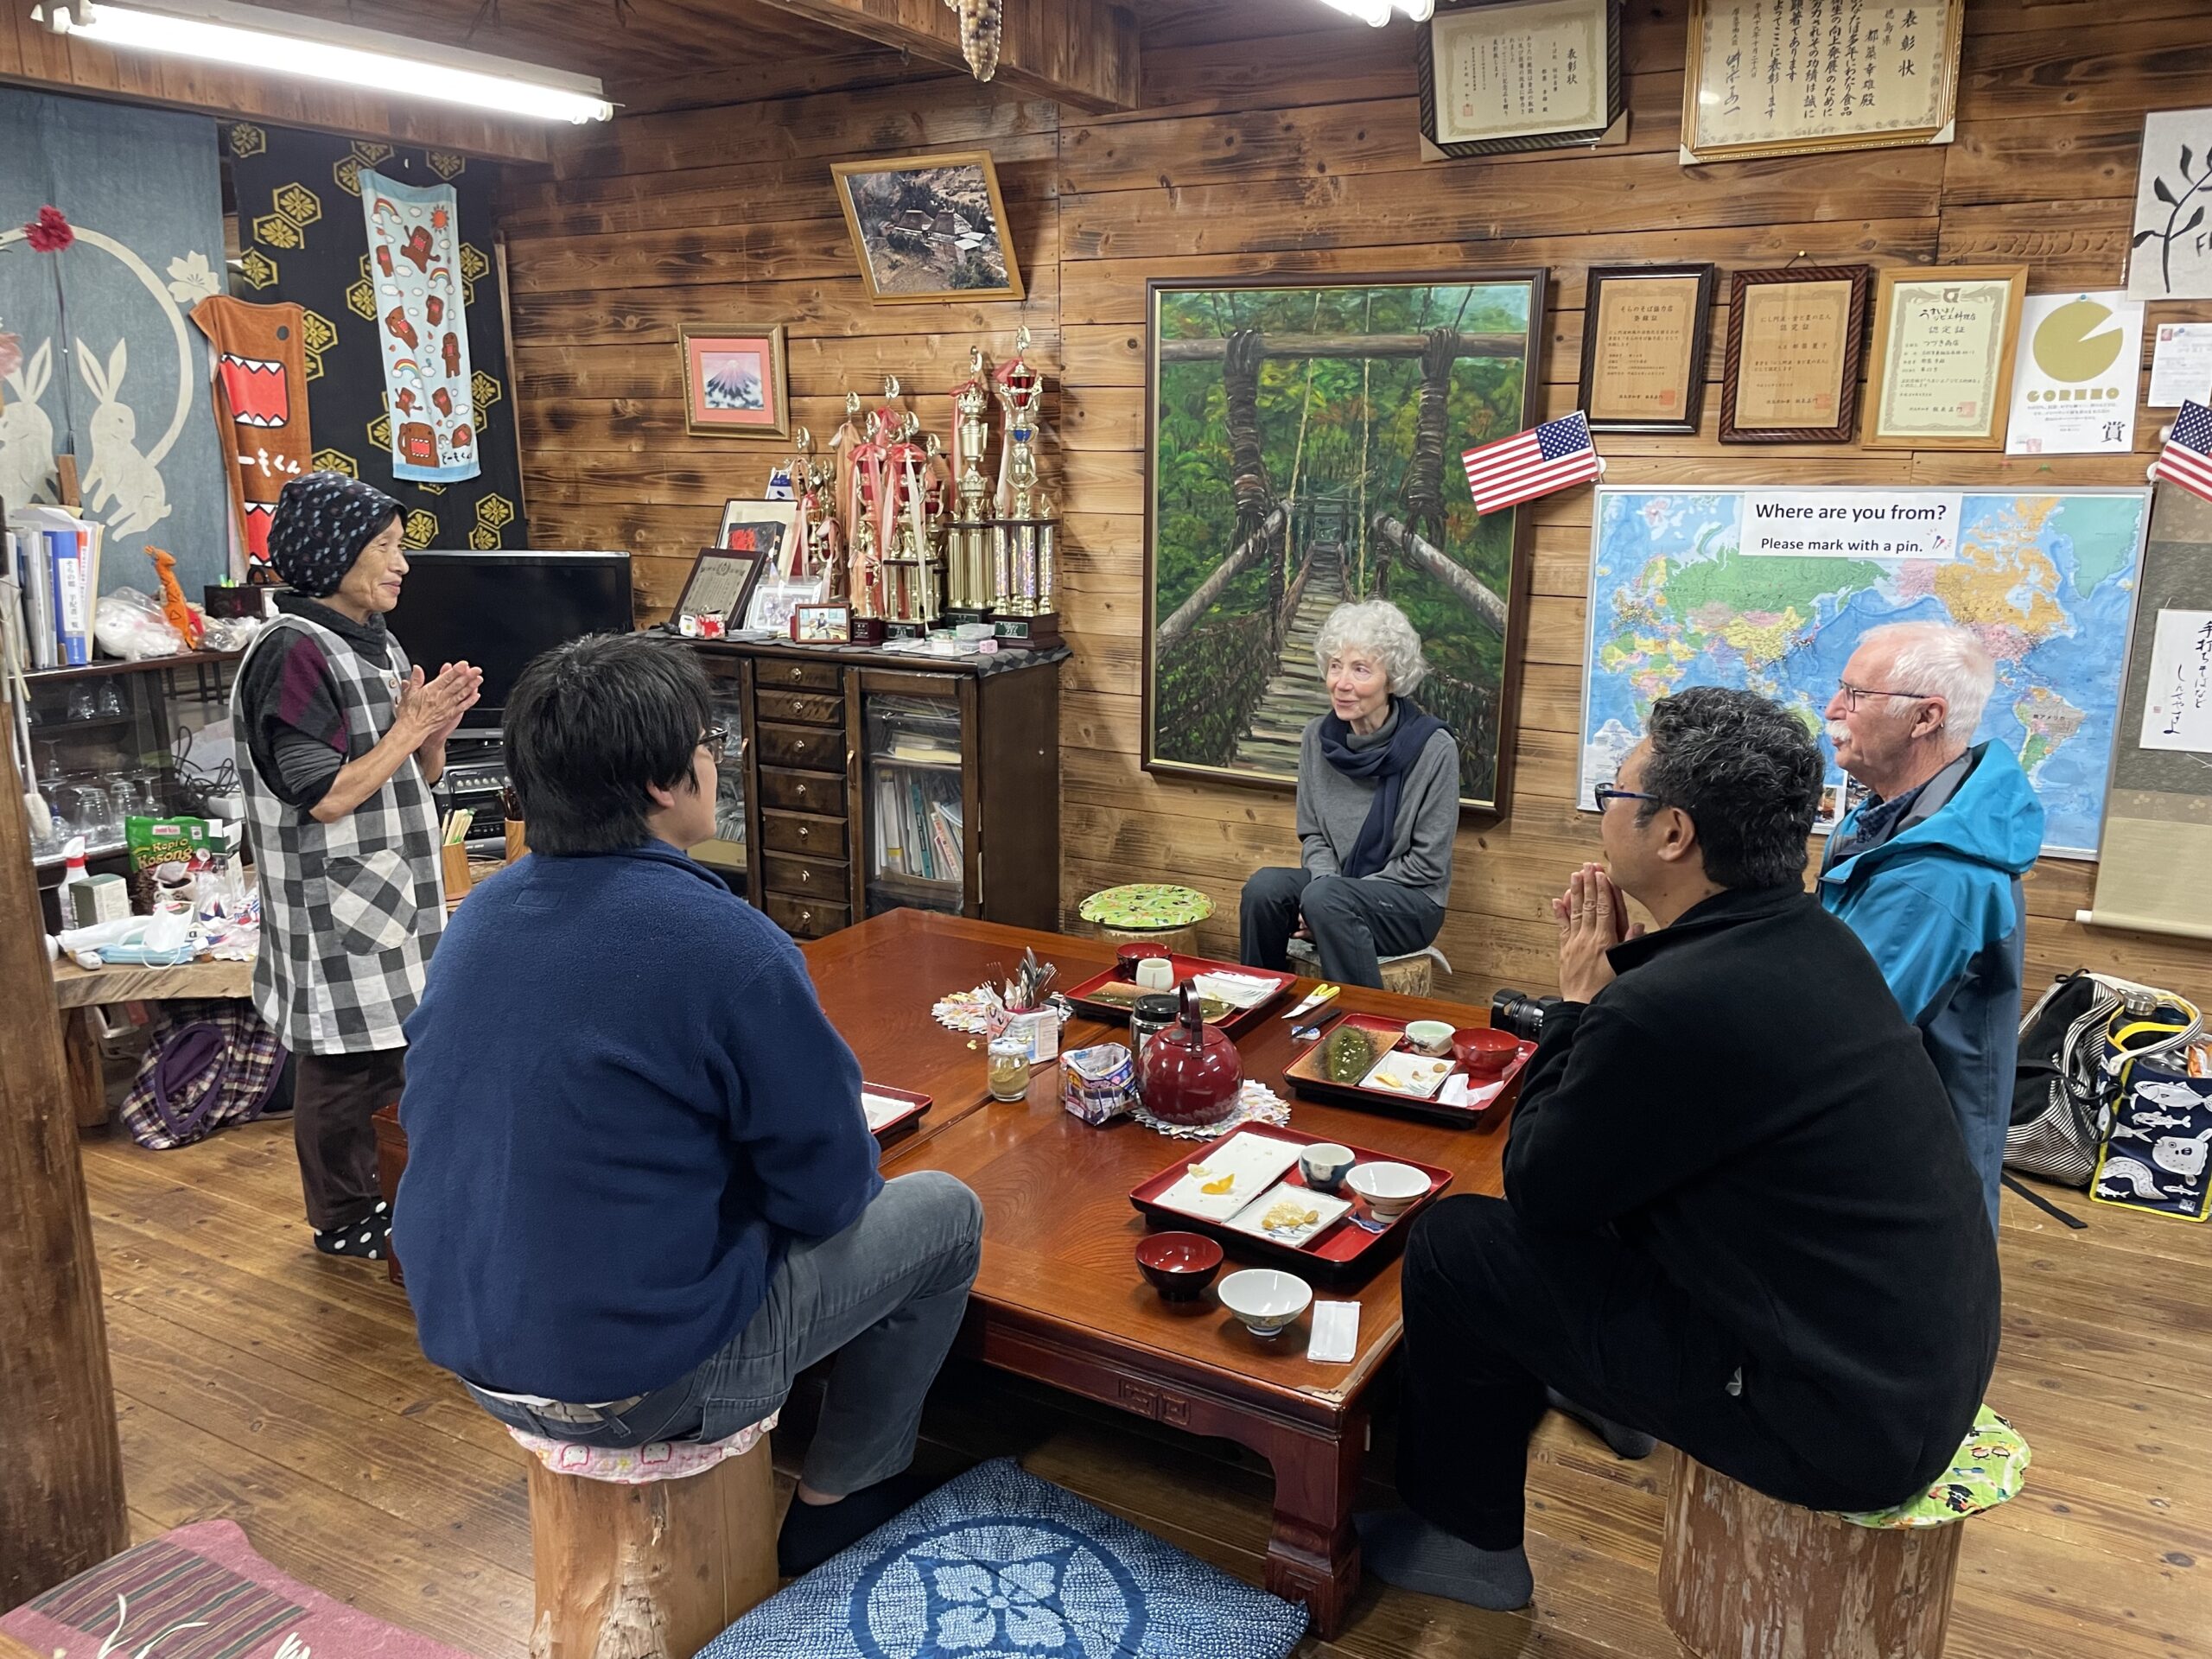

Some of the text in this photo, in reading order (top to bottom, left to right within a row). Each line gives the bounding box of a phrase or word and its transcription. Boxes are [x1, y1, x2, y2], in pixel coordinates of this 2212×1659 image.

[1882, 9, 1895, 46] 徳島県
[1898, 9, 1918, 77] 表彰状
[1567, 48, 1578, 85] 表彰状
[1840, 0, 1863, 116] なたは多年にわたり食品
[2101, 421, 2126, 442] 賞
[1756, 504, 1947, 522] Where are you from?
[1761, 538, 1923, 554] Please mark with a pin.
[137, 846, 193, 868] Kosong
[153, 841, 178, 852] Kopi
